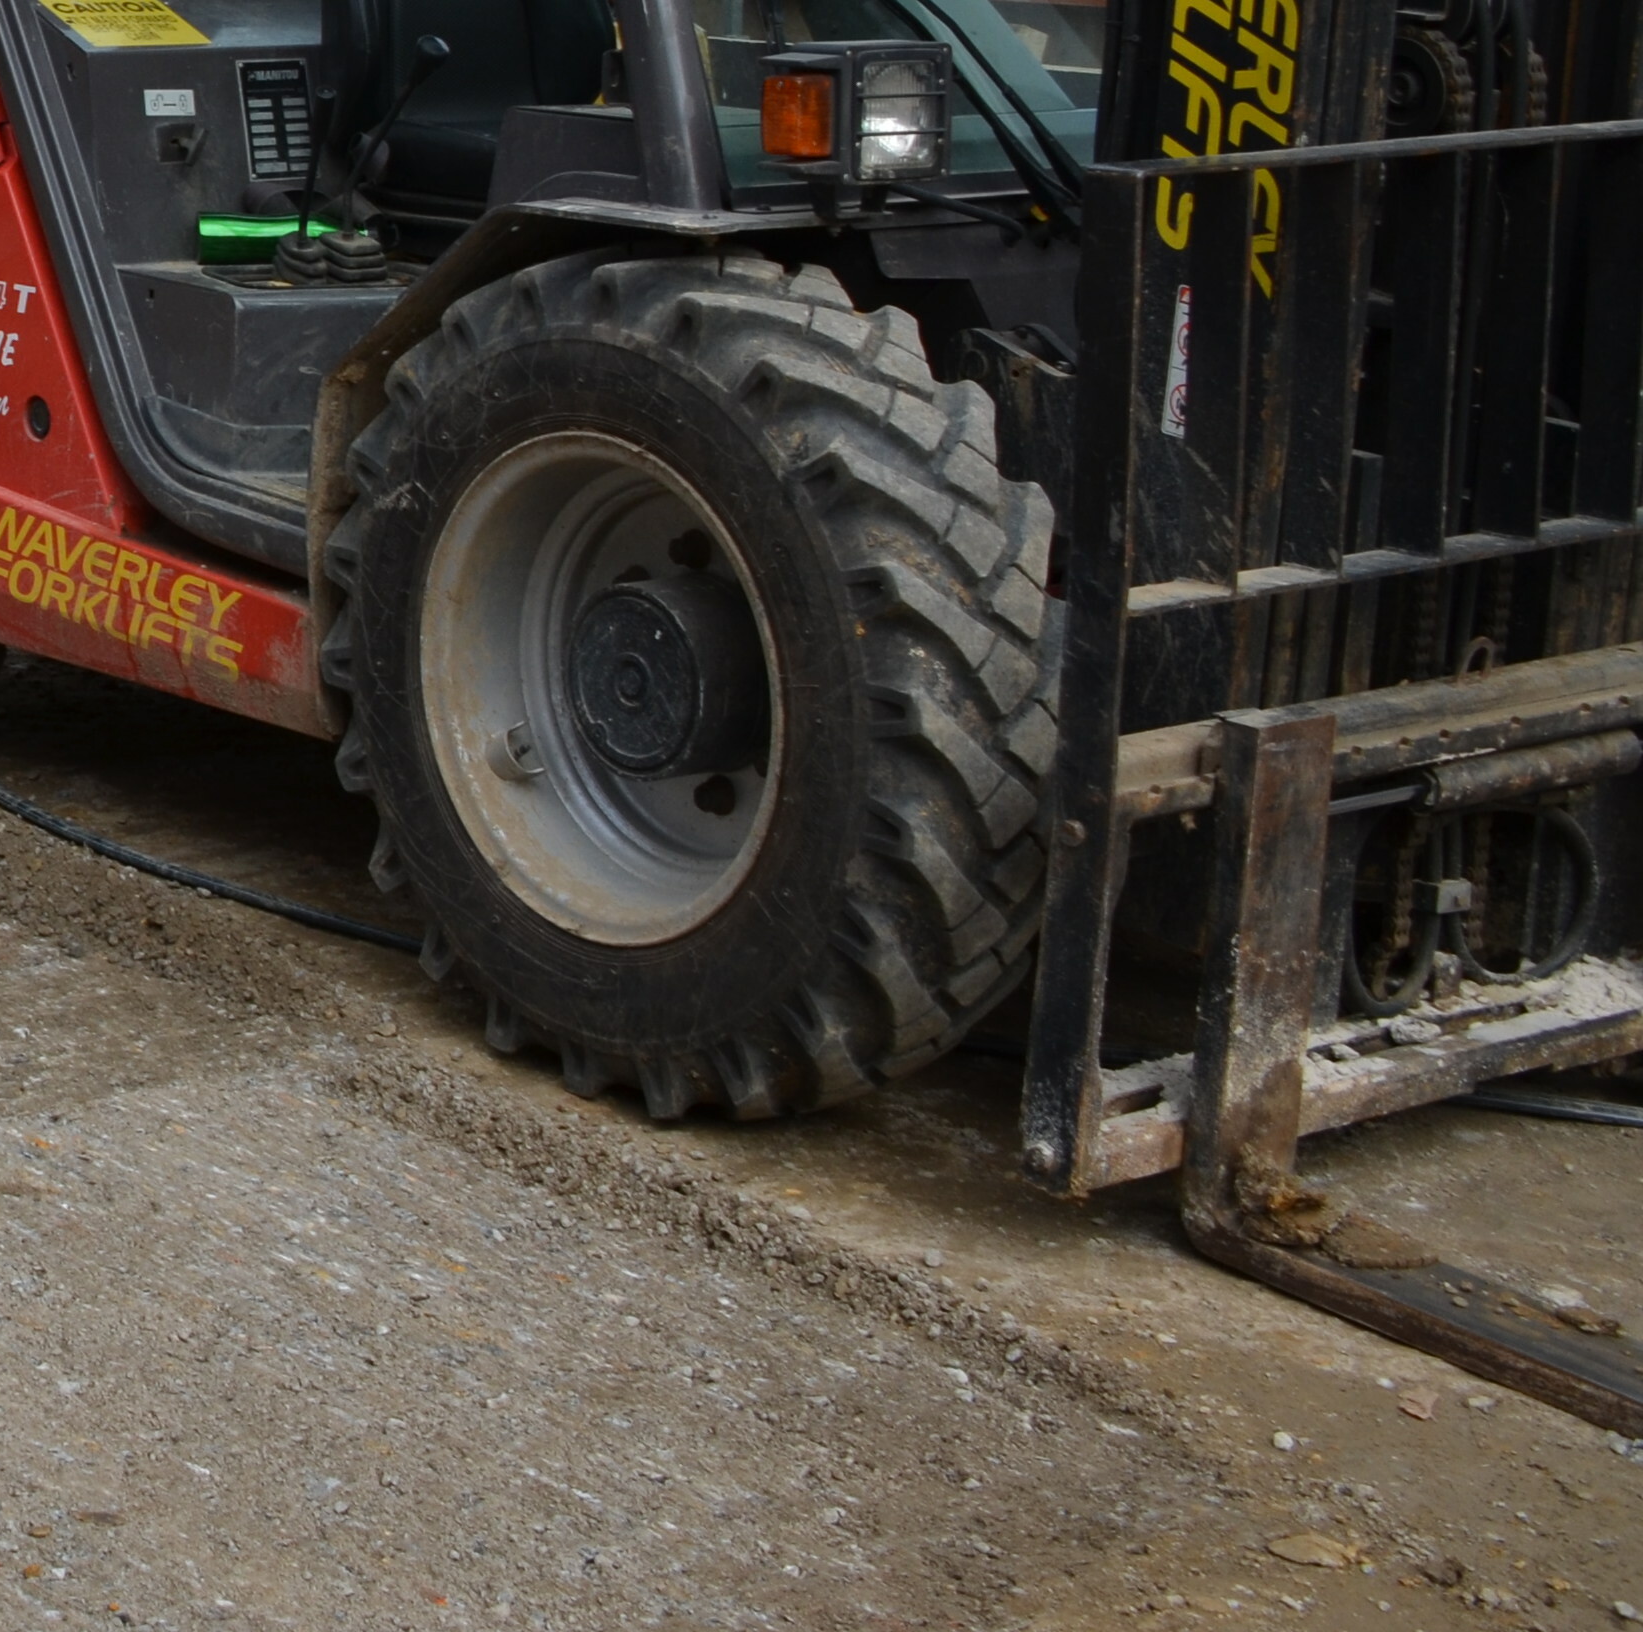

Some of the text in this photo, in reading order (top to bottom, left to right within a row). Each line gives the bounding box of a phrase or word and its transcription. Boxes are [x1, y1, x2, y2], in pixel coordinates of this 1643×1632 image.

[52, 1, 166, 14] CAUTION
[255, 69, 299, 81] MANITOU
[13, 283, 37, 314] T
